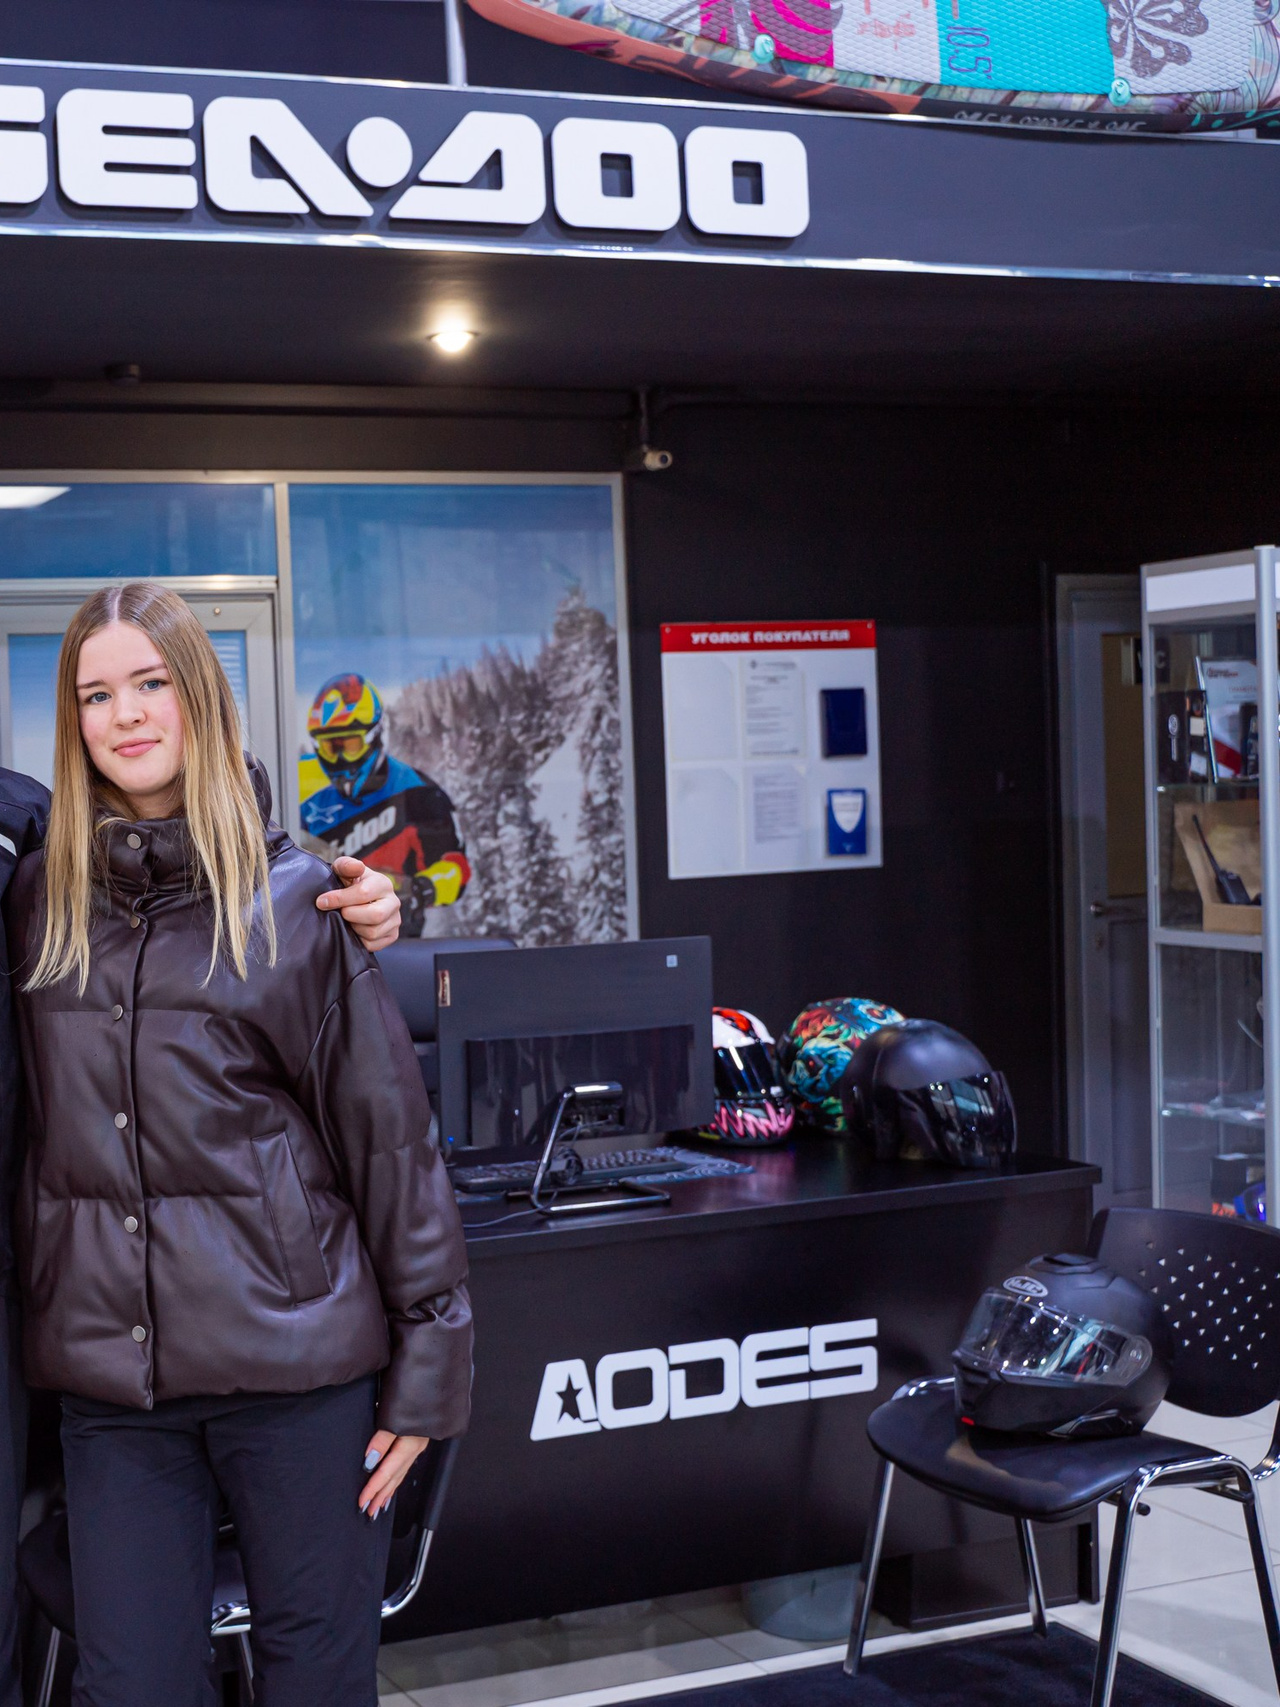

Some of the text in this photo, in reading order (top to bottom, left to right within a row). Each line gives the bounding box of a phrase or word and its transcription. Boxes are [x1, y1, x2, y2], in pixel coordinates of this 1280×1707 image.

[691, 629, 850, 645] УГОЛОК ПОКУПАТЕЛЯ
[530, 1318, 878, 1441] AODES
